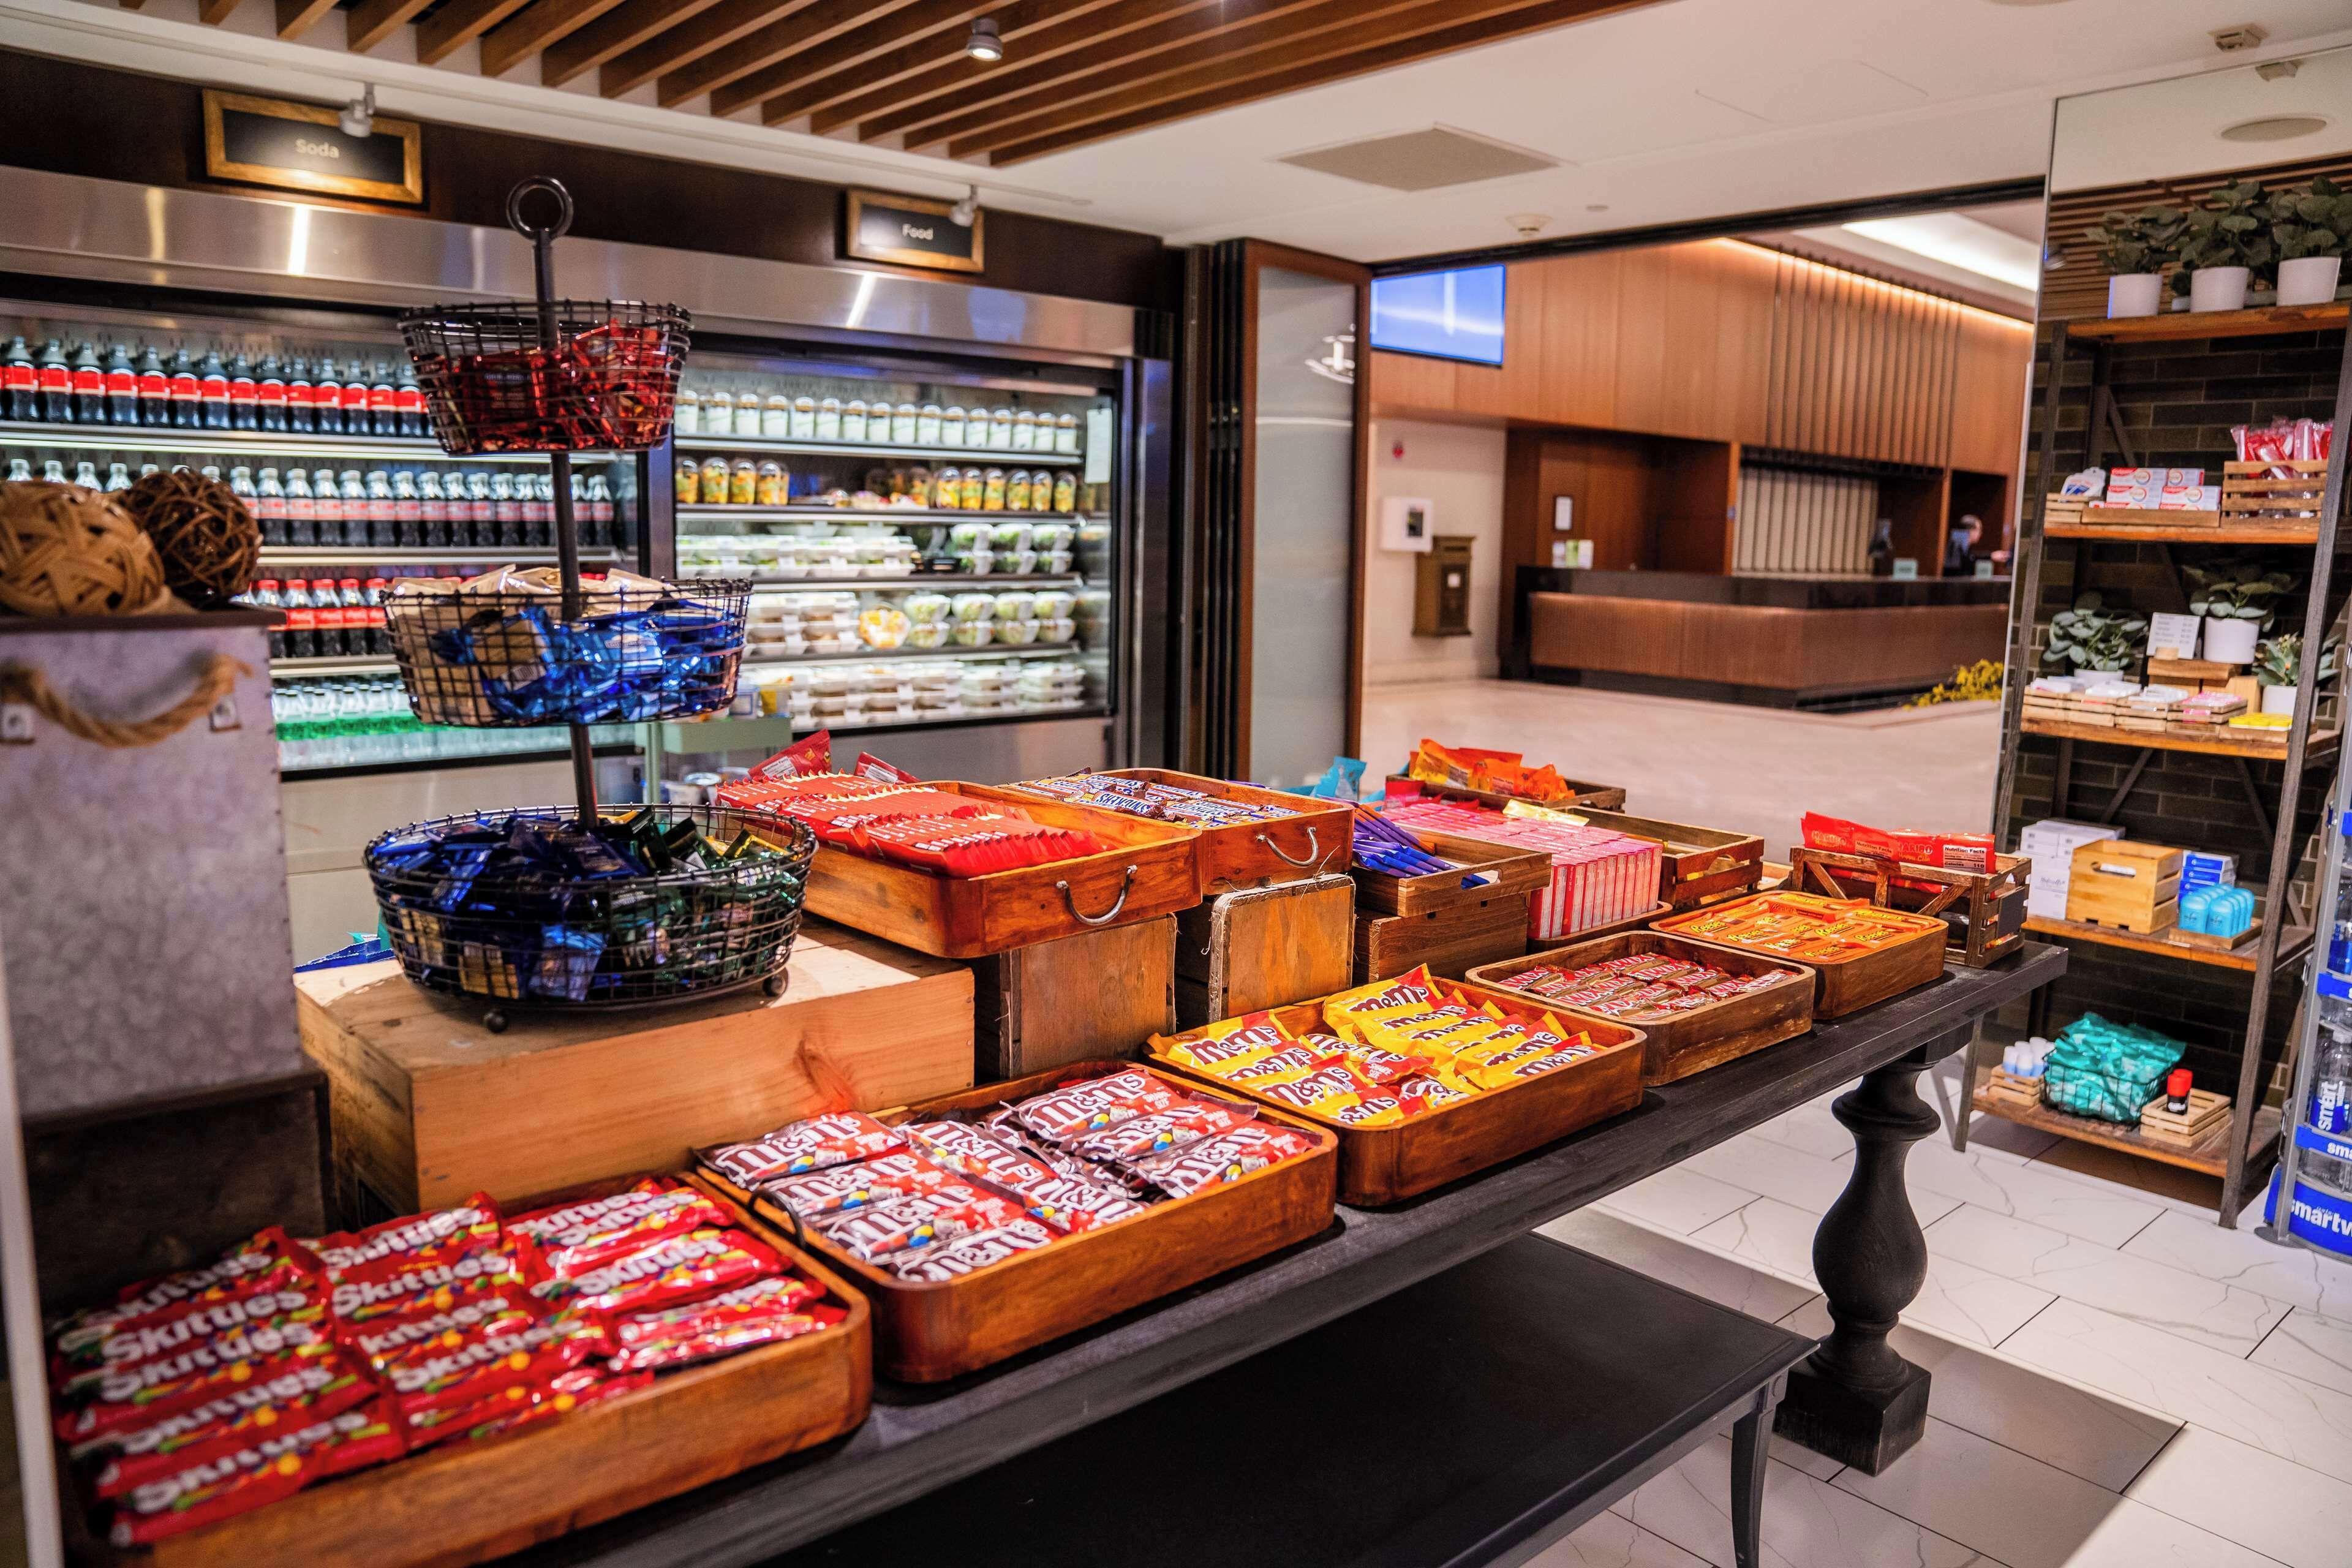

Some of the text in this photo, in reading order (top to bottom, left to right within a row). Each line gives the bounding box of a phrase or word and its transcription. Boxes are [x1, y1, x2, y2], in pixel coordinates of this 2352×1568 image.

[295, 138, 339, 158] Soda
[902, 224, 933, 240] Food
[1095, 793, 1152, 813] SNICKERS
[1856, 841, 1893, 854] Nutrition Facts
[1690, 920, 1726, 933] Reese's
[1814, 922, 1849, 937] Reese's
[1348, 984, 1430, 1012] m&m's
[1182, 1025, 1279, 1067] m&m's
[1224, 1048, 1313, 1081] m&m's
[1144, 1091, 1171, 1103] SHARE
[1155, 1099, 1170, 1110] SIZE
[1259, 1066, 1353, 1107] m&m's
[2317, 1080, 2337, 1132] smart
[1018, 1073, 1147, 1142] m&m's
[1340, 1097, 1400, 1125] &m's
[907, 1120, 1044, 1181] m&m's
[320, 1207, 483, 1270] Skittles
[559, 1194, 698, 1246] Skittles
[331, 1253, 510, 1317] Skittles
[572, 1238, 728, 1295] Skittles
[100, 1290, 307, 1363] Skittles
[358, 1297, 510, 1355] kittles
[100, 1322, 315, 1403] Skittles
[390, 1319, 584, 1393] Skittles
